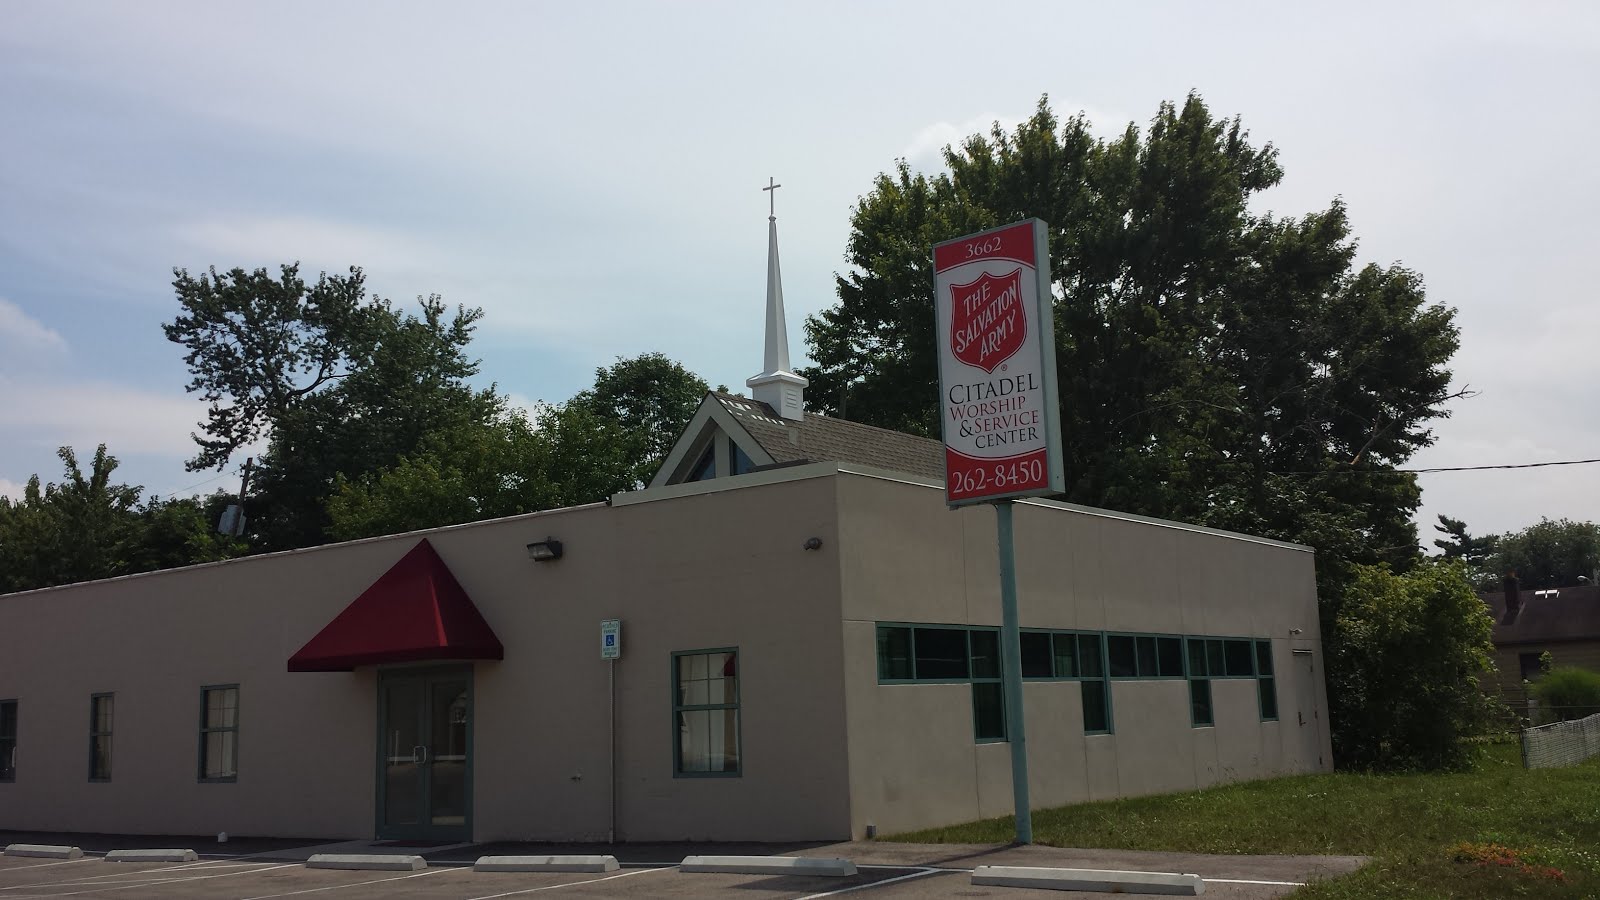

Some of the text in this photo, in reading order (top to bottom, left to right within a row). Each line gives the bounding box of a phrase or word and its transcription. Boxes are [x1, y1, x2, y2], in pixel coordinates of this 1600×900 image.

[965, 237, 1002, 258] 3662
[963, 280, 991, 316] THE
[955, 280, 1017, 354] SALVATION
[979, 309, 1017, 363] ARMY
[949, 374, 1039, 405] CITADEL
[950, 396, 1026, 422] WORSHIP
[975, 426, 1039, 449] CENTER
[953, 459, 1042, 494] 262-8450
